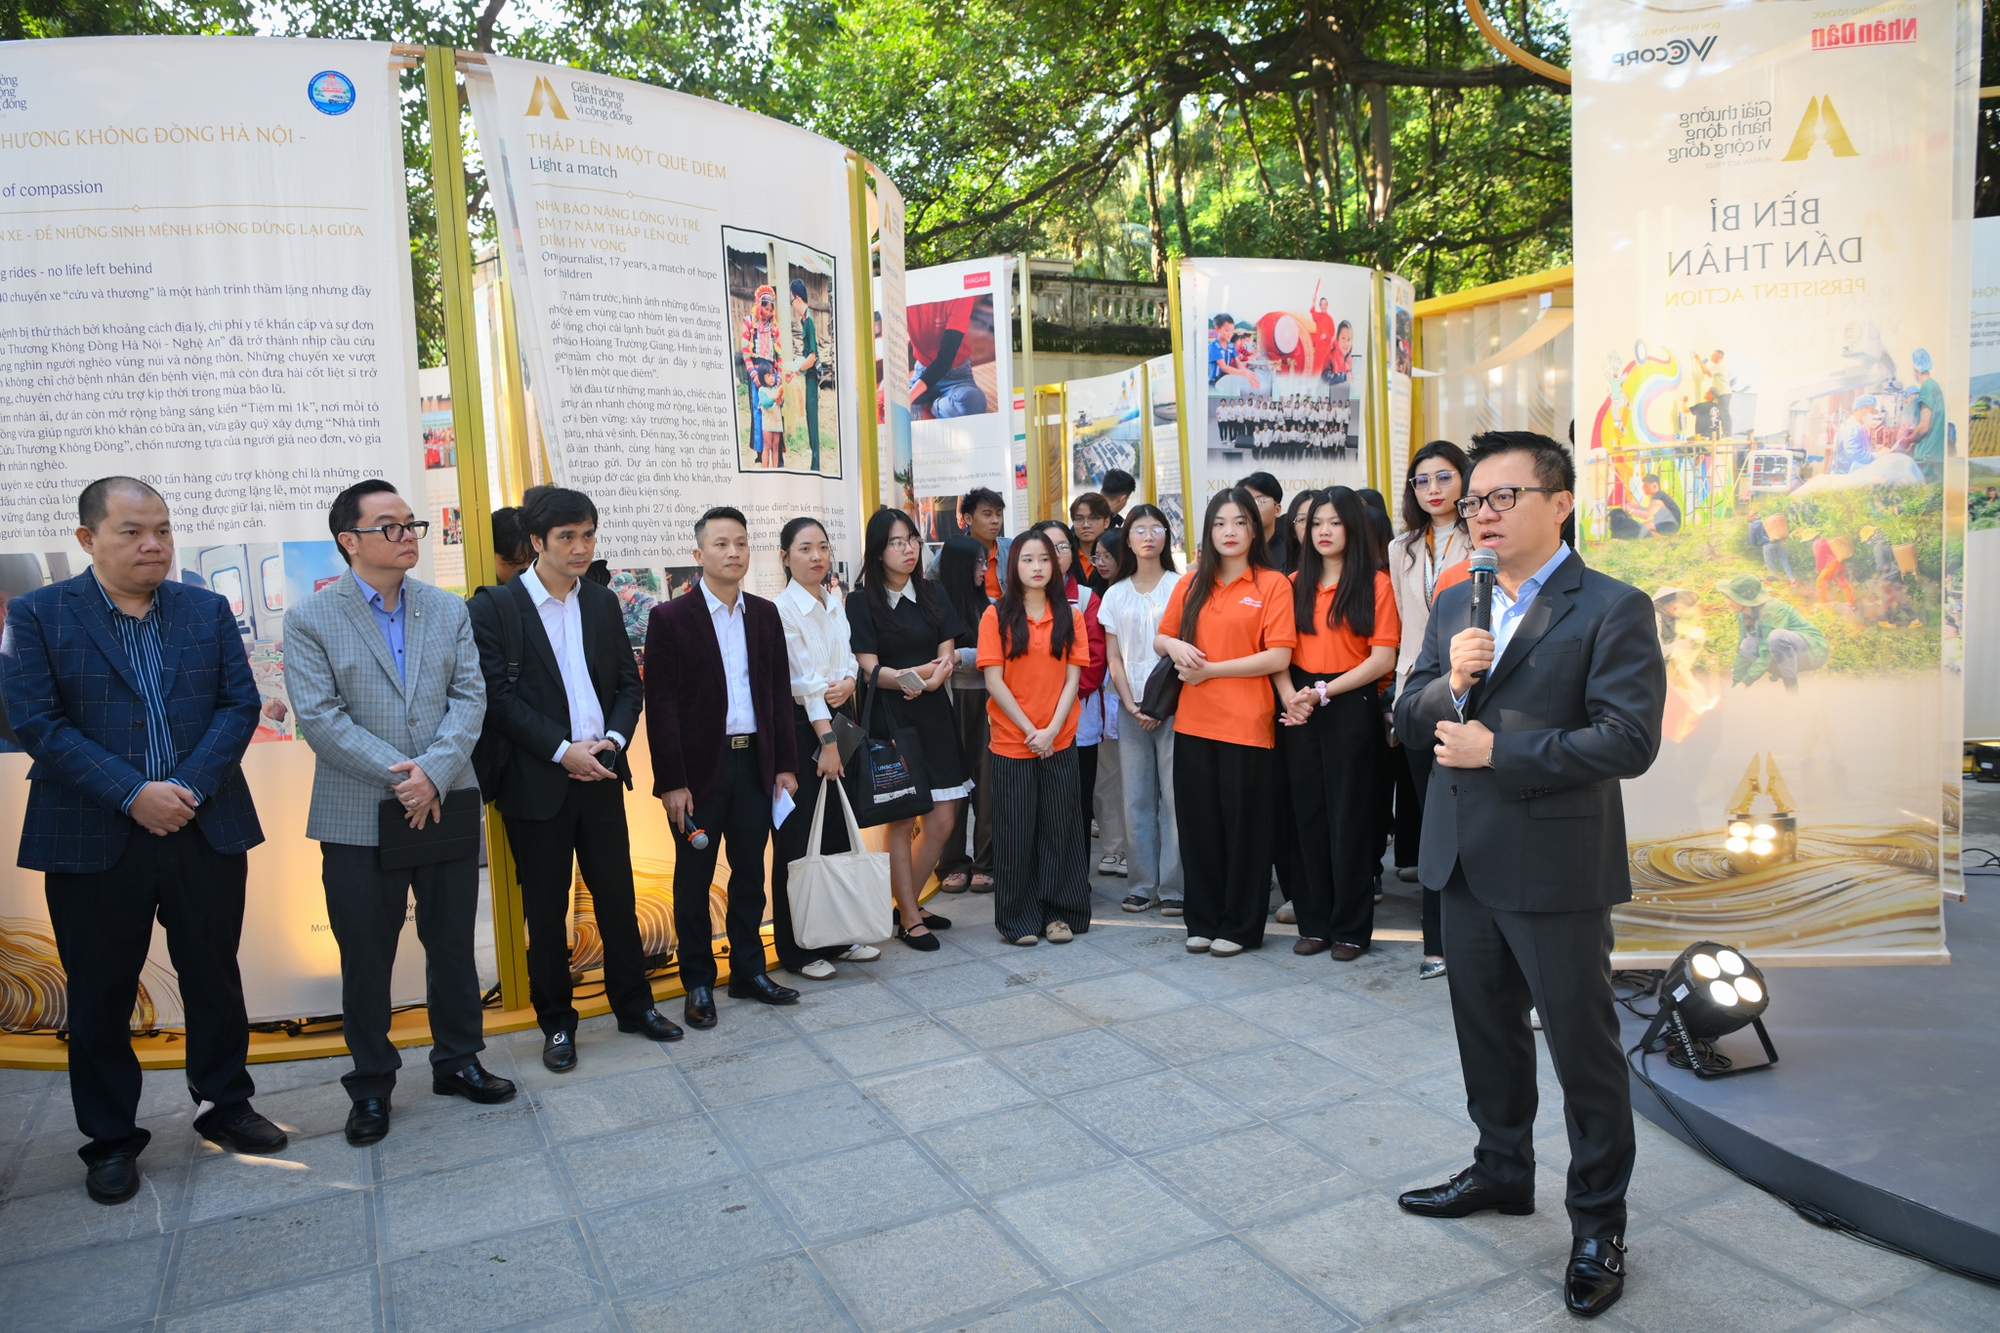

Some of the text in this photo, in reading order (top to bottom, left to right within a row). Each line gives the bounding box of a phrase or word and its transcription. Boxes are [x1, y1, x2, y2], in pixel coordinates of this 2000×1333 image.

[571, 81, 624, 102] Giải thưởng
[573, 92, 622, 112] hành động
[575, 104, 633, 125] vì cộng đồng
[76, 125, 148, 146] KHÔNG
[154, 122, 214, 144] ĐỒNG
[220, 122, 250, 142] HÀ
[256, 124, 293, 146] NỘI
[526, 132, 726, 179] THẮP LÊN MỘT QUE DIÊM
[530, 156, 618, 179] Light a match
[2, 180, 104, 198] of compassion
[563, 202, 590, 216] BÁO
[594, 205, 630, 220] NẶNG
[632, 210, 664, 226] LÒNG
[668, 213, 678, 228] VÌ
[681, 217, 700, 232] TRẺ
[7, 230, 23, 242] XE
[35, 224, 52, 241] ĐỂ
[56, 224, 108, 240] NHỮNG
[112, 226, 146, 238] SINH
[149, 222, 191, 238] MỆNH
[196, 220, 248, 235] KHÔNG
[252, 220, 296, 235] DỪNG
[300, 222, 323, 237] LẠI
[327, 222, 364, 236] GIỮA
[538, 218, 690, 246] EM 17 NĂM THẮP LÊN QUE
[569, 238, 626, 253] HY VỌNG
[9, 266, 36, 278] rides
[48, 267, 62, 277] no
[66, 264, 82, 276] life
[86, 263, 106, 276] left
[109, 262, 152, 275] behind
[544, 267, 592, 280] for hildren
[610, 257, 620, 266] 17
[622, 259, 650, 271] years,
[659, 264, 686, 275] match
[687, 266, 696, 276] of
[698, 268, 717, 280] hope
[965, 276, 988, 284] HAGAR
[10, 290, 46, 304] chuyến
[50, 293, 60, 301] xe
[92, 290, 104, 299] và
[158, 286, 166, 297] là
[170, 286, 192, 299] một
[196, 284, 220, 296] hành
[224, 284, 250, 294] trình
[253, 282, 282, 294] thầm
[286, 284, 308, 296] lặng
[312, 284, 348, 297] nhưng
[352, 284, 372, 298] đầy
[8, 344, 48, 356] Thương
[52, 342, 85, 354] Không
[88, 340, 118, 352] Đồng
[122, 340, 139, 350] Hà
[143, 339, 162, 351] Nội
[173, 338, 203, 350] Nghệ
[229, 336, 244, 346] đã
[247, 336, 264, 346] trở
[266, 335, 298, 346] thành
[302, 336, 327, 348] nhịp
[330, 334, 350, 346] cầu
[354, 336, 374, 346] cứu
[14, 412, 36, 422] nhân
[40, 412, 52, 423] ái,
[56, 410, 68, 422] dự
[71, 410, 83, 420] án
[86, 410, 105, 419] còn
[108, 408, 128, 418] mở
[130, 408, 157, 420] rộng
[160, 406, 186, 418] bằng
[190, 406, 215, 417] sáng
[218, 402, 238, 414] kiến
[242, 402, 274, 414] “Tiệm
[278, 402, 292, 412] mì
[322, 402, 340, 412] nơi
[343, 400, 364, 412] mỗi
[368, 402, 379, 412] tô
[1206, 480, 1230, 491] XIN
[311, 924, 331, 932] Mor
